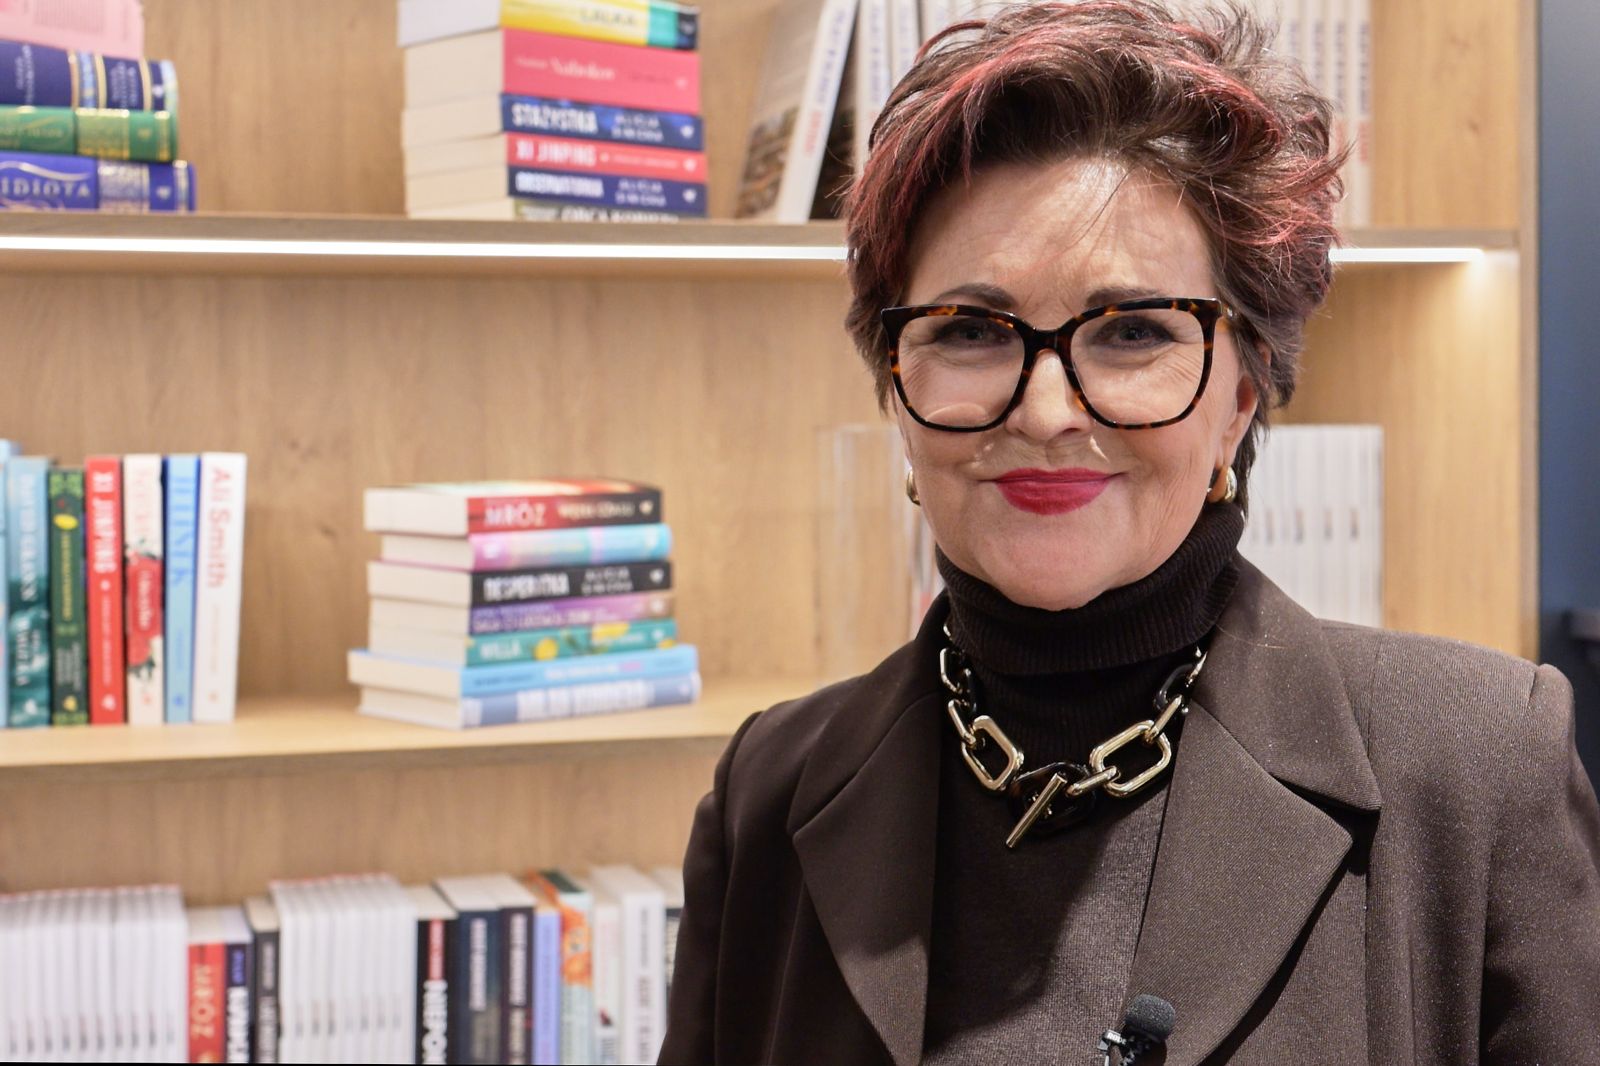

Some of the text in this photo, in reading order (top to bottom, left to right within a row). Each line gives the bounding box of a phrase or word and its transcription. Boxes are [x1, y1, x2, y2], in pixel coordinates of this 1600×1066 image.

[1, 177, 91, 198] IDIOTA
[211, 466, 232, 503] Ali
[207, 509, 231, 589] Smith
